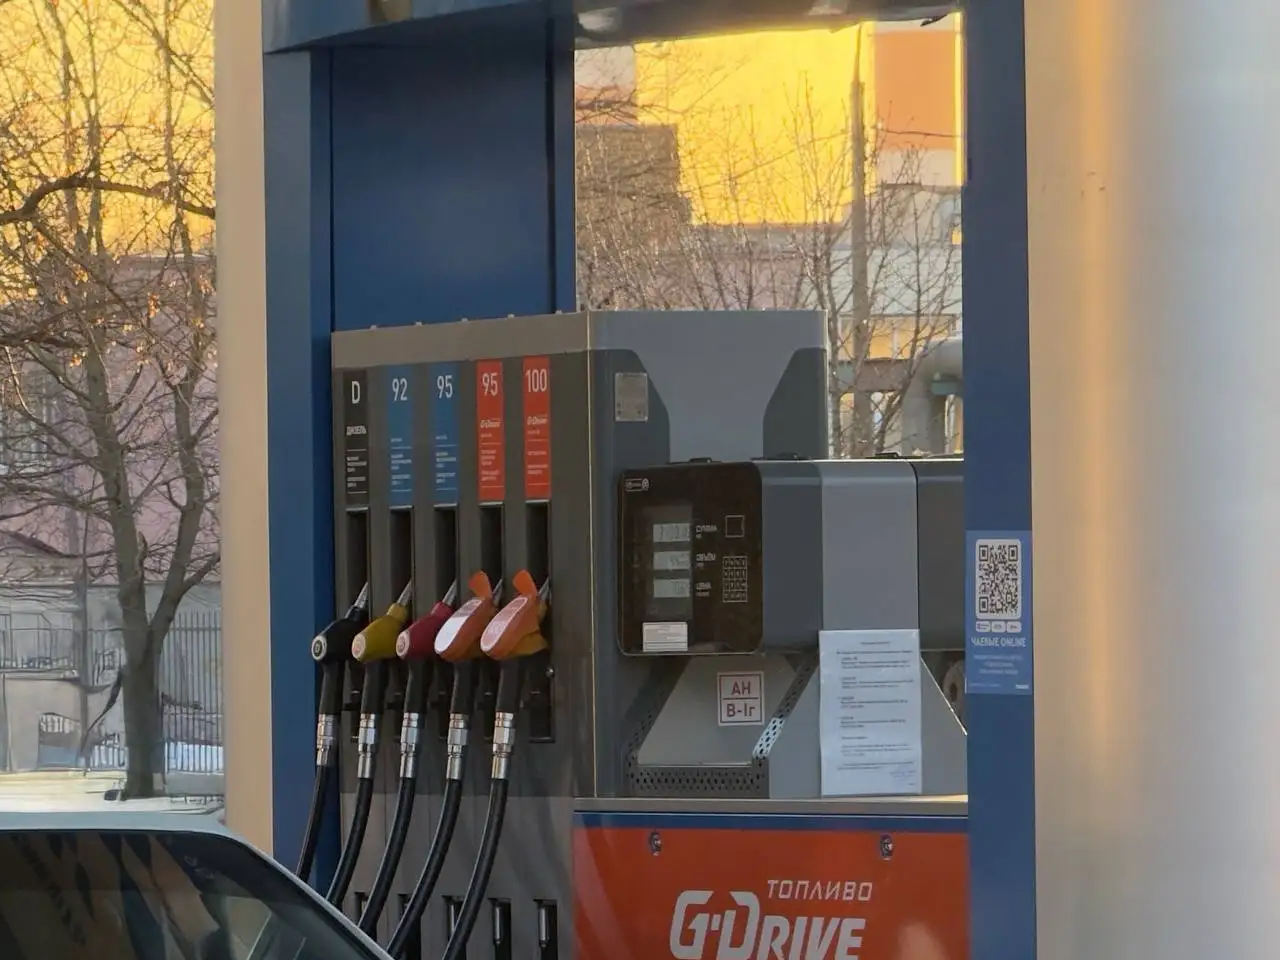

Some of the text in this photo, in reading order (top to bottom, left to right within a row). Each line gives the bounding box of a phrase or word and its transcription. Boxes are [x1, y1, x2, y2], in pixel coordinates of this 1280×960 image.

[351, 380, 361, 404] D
[391, 377, 408, 401] 92
[436, 374, 453, 399] 95
[481, 371, 498, 397] 95
[525, 368, 548, 393] 100
[767, 879, 873, 901] ТОПЛИВО
